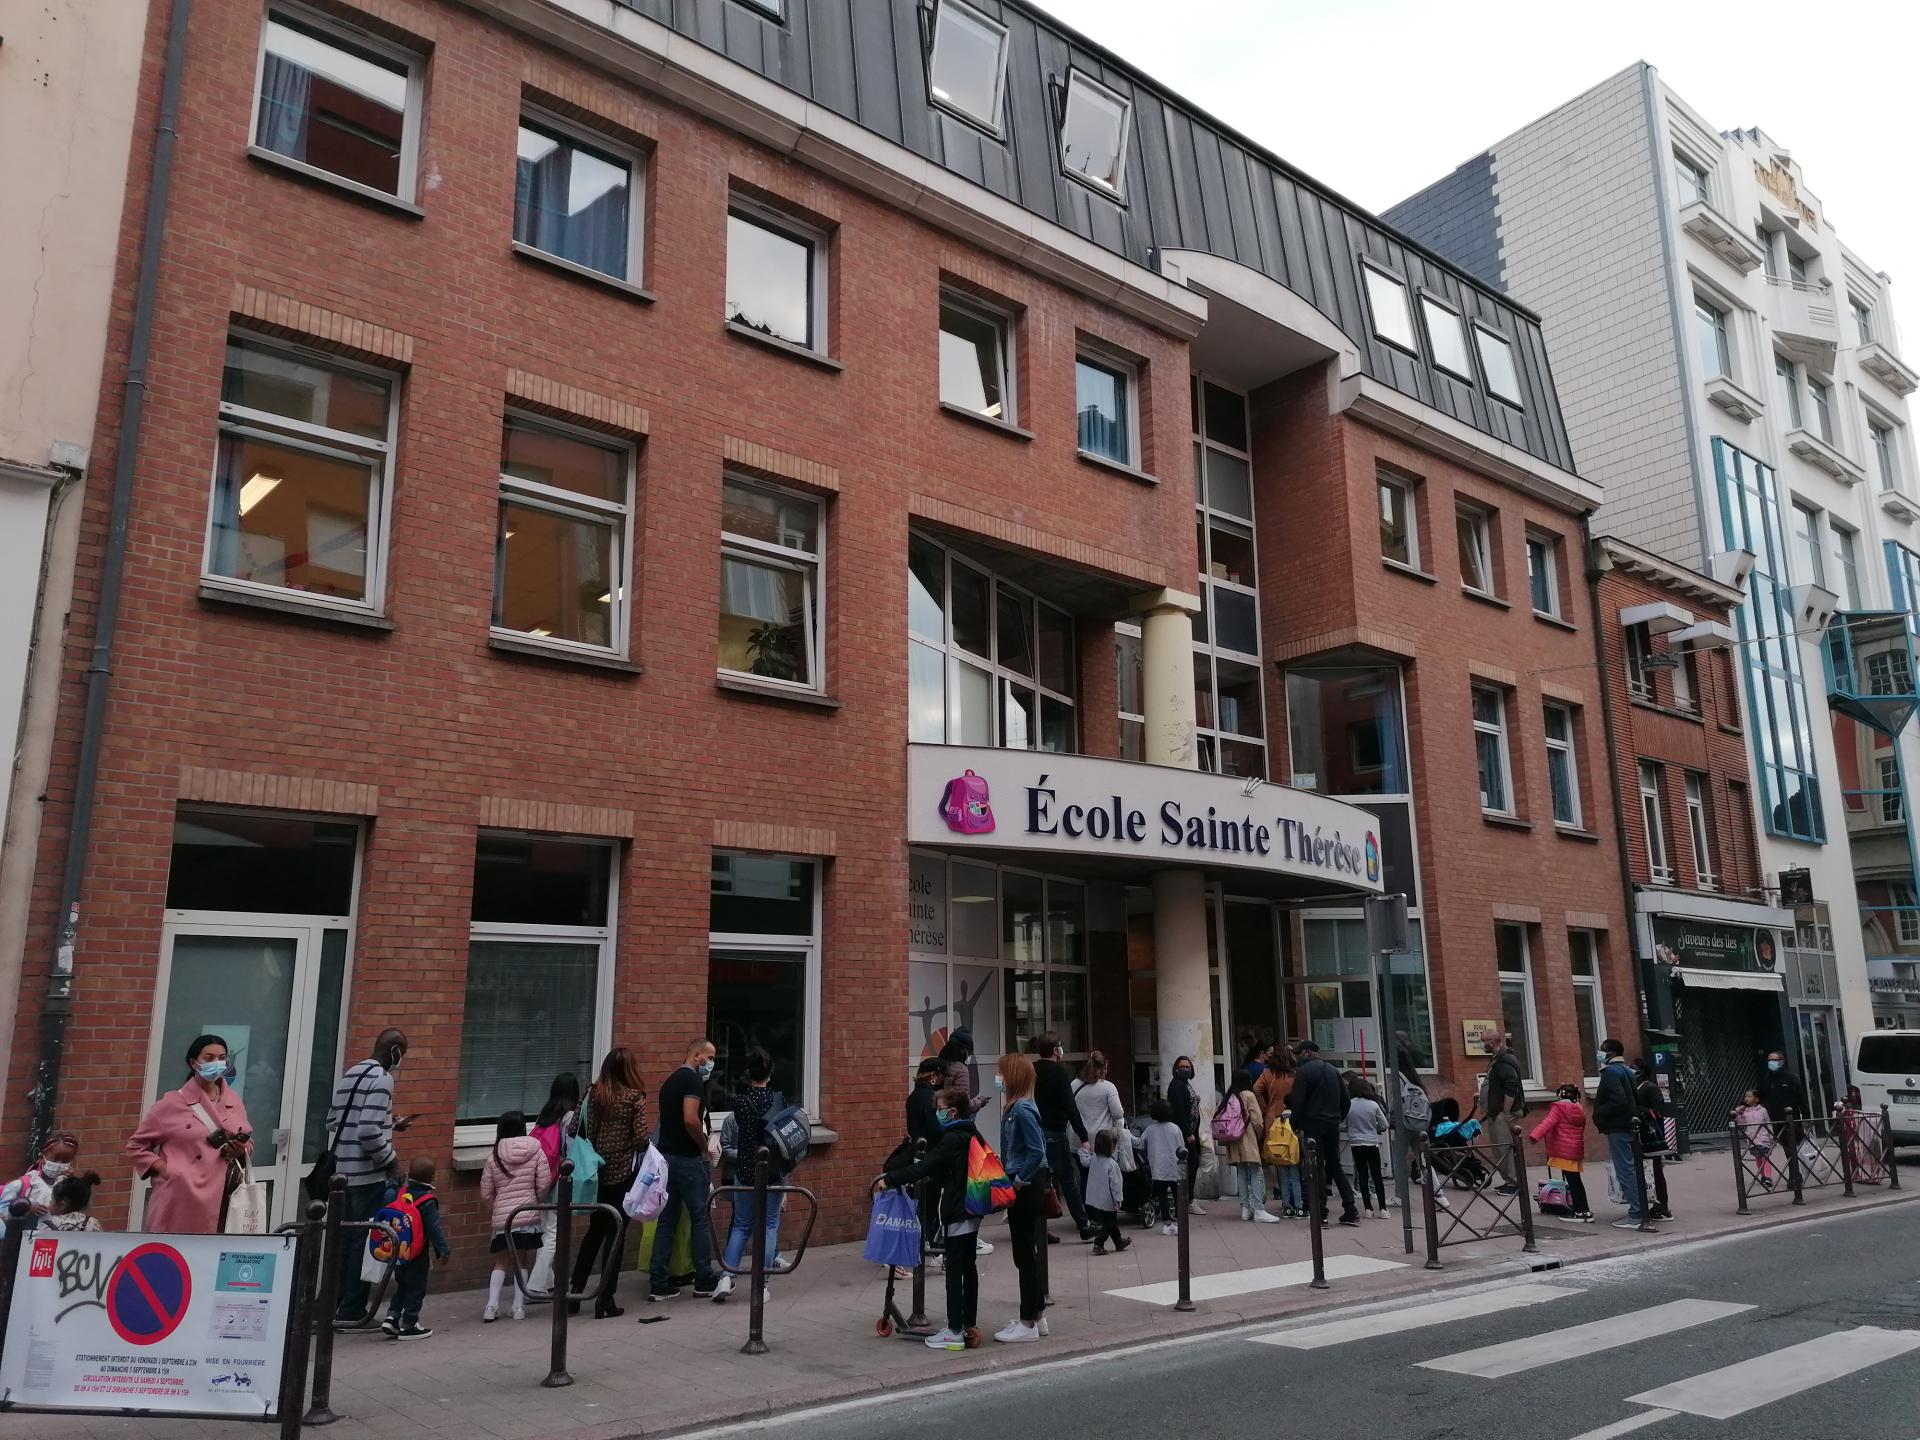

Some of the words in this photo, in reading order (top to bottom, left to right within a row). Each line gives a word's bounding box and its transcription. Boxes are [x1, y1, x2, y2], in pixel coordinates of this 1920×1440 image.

[1025, 774, 1146, 842] École
[1160, 800, 1271, 856] Sainte
[1278, 817, 1362, 876] Thérèse
[909, 875, 932, 895] cole
[909, 901, 935, 920] inte
[1678, 926, 1710, 950] Saveurs
[1712, 932, 1725, 948] des
[1656, 1053, 1663, 1064] P
